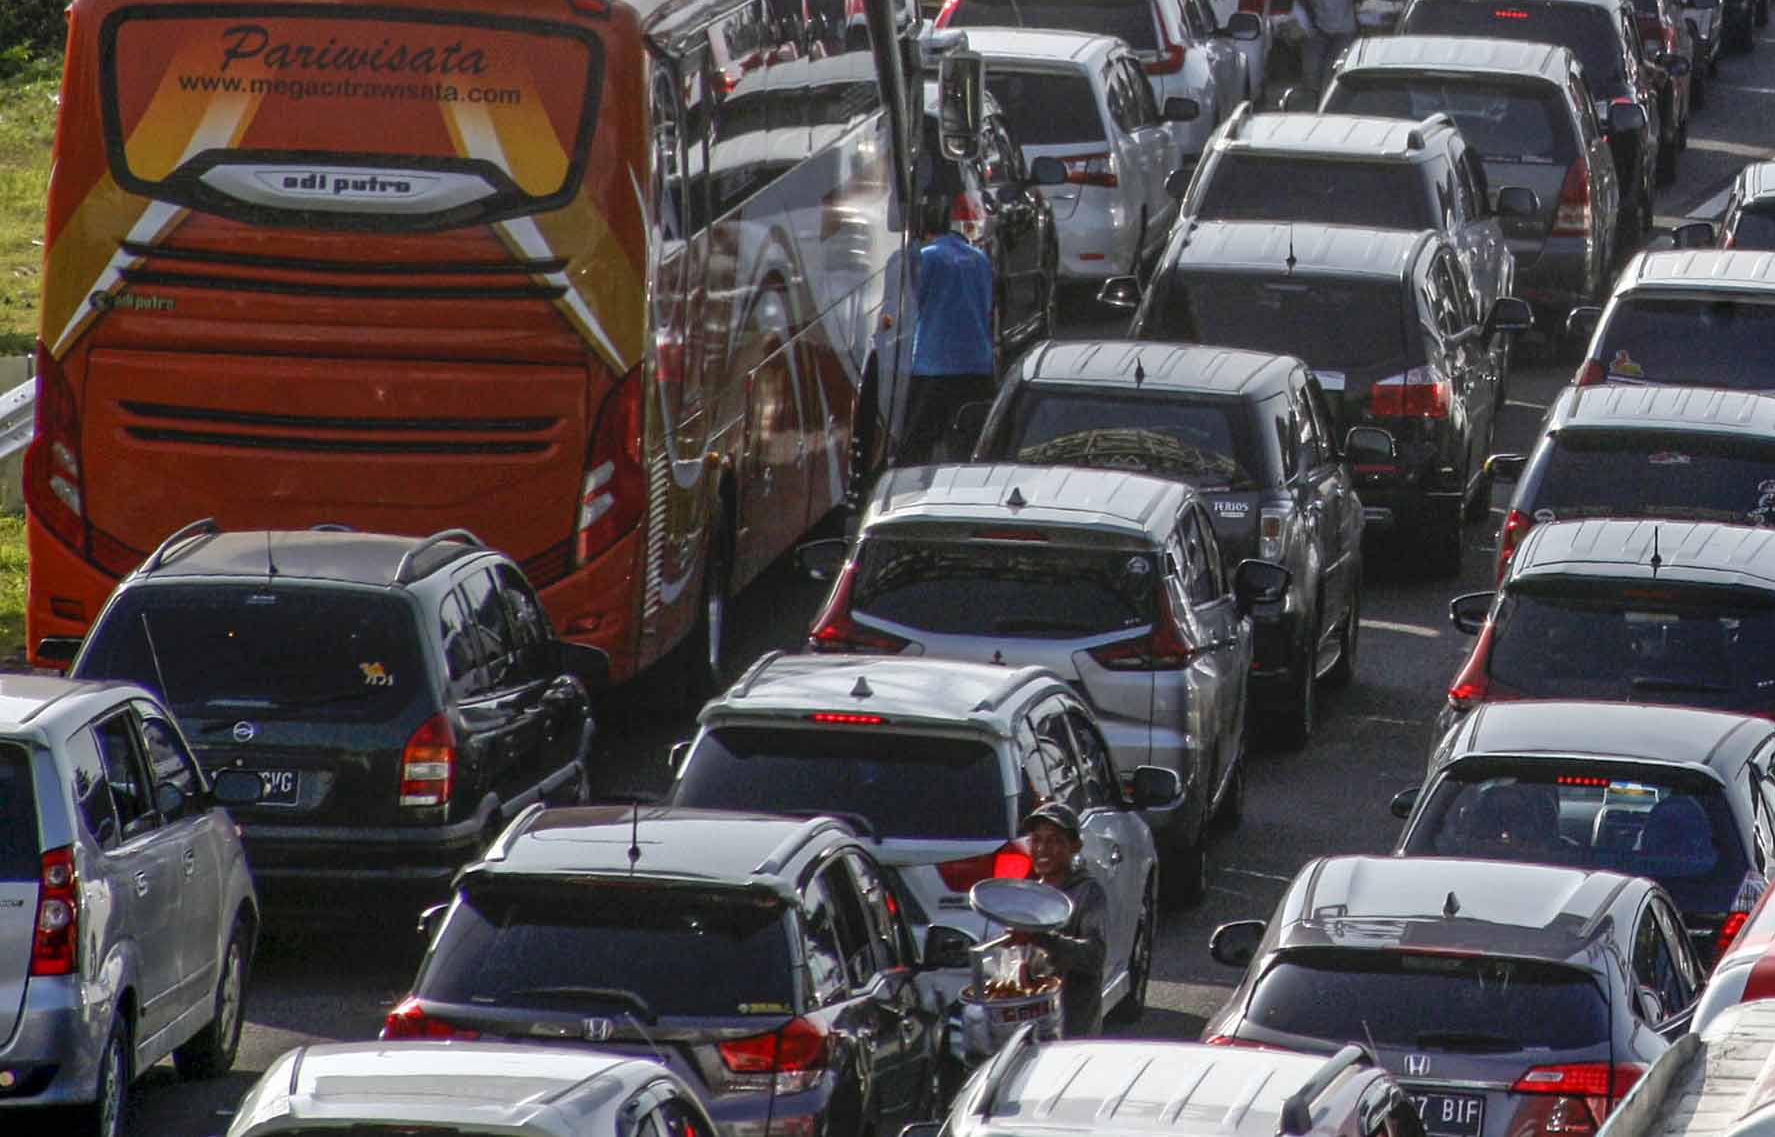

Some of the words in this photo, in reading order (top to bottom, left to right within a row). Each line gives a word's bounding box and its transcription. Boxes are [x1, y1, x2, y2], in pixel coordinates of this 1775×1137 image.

[221, 24, 489, 75] Pariwisata
[178, 74, 522, 105] www.megacitrawisata.com
[282, 174, 326, 191] adi
[1442, 1098, 1478, 1124] BIF
